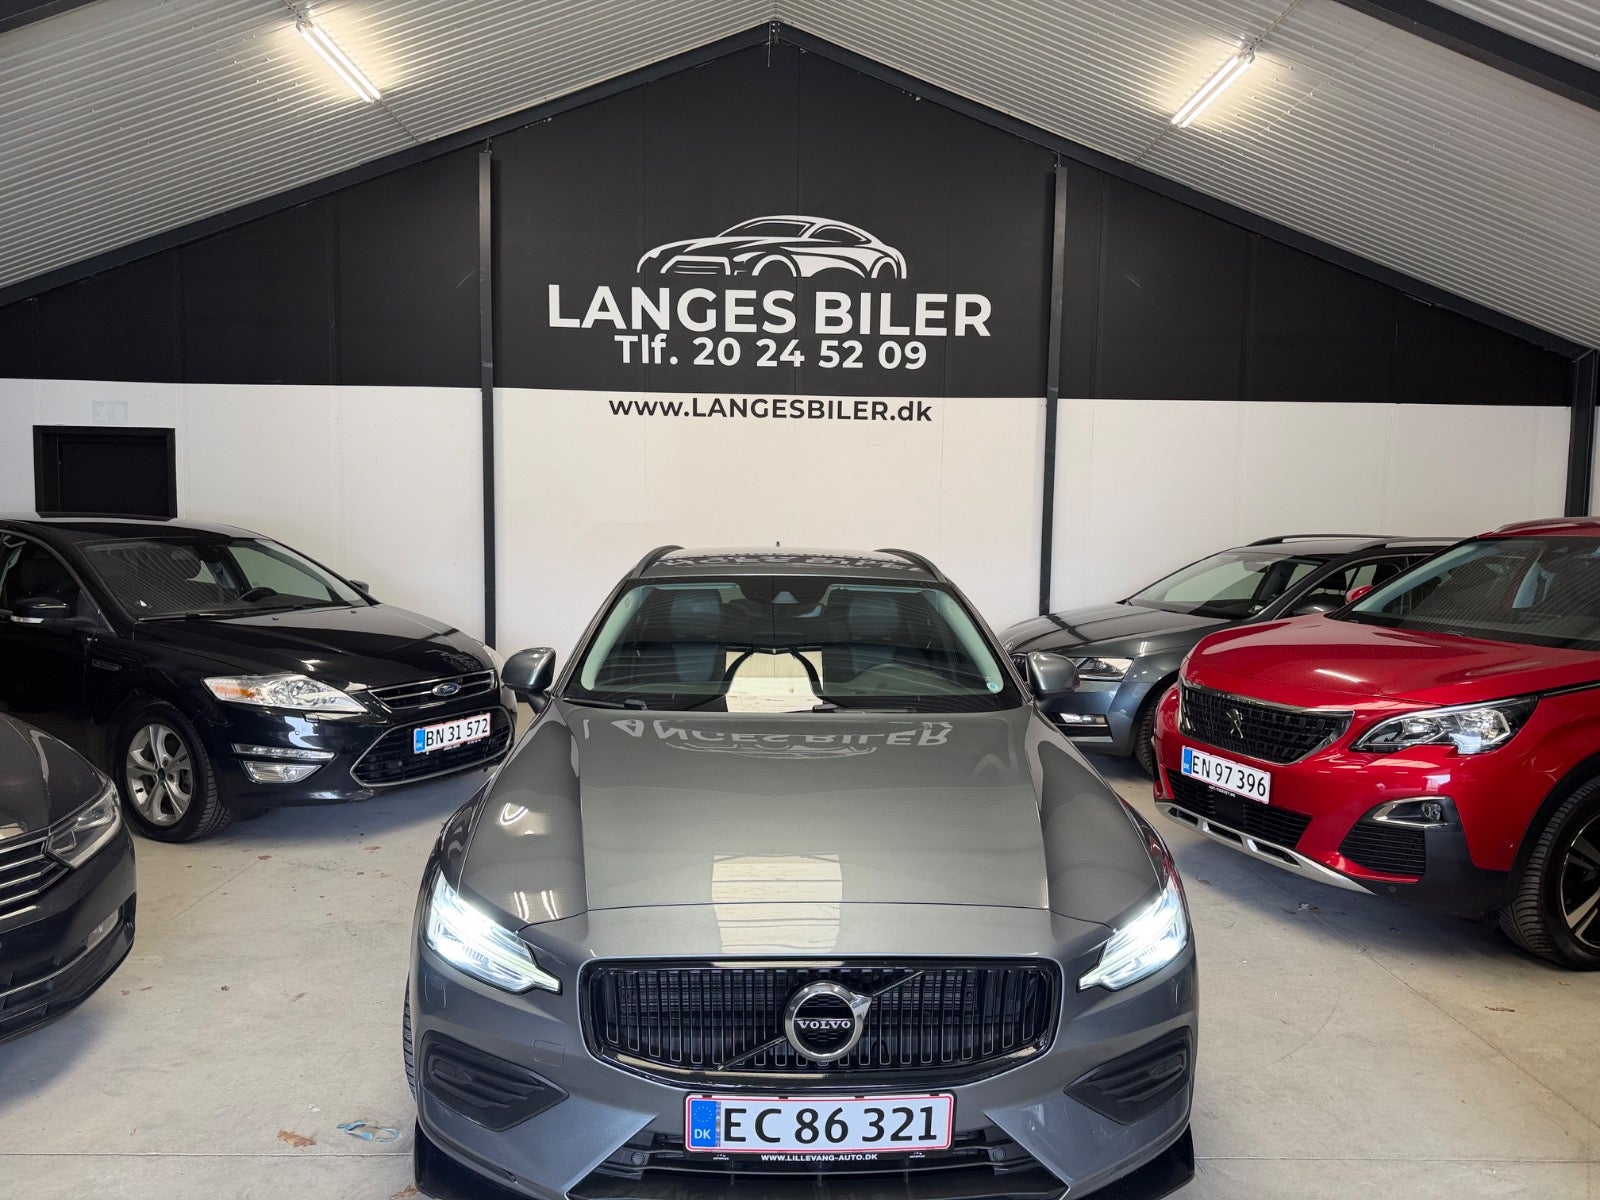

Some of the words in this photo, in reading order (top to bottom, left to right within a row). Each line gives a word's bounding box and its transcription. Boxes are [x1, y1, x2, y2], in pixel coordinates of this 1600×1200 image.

[548, 284, 797, 334] LANGES
[814, 290, 992, 337] BILER
[614, 333, 679, 365] Tlf.
[692, 337, 741, 367] 20
[756, 339, 805, 368] 24
[818, 340, 863, 369] 52
[878, 341, 927, 370] 09
[608, 397, 933, 422] www.LANGESBILER.dk
[426, 728, 444, 746] BN
[447, 725, 461, 742] 31
[466, 718, 488, 737] 572
[1192, 755, 1211, 779] EN
[1215, 763, 1232, 784] 97
[1236, 769, 1266, 797] 396
[797, 1020, 851, 1029] VOLVO
[694, 1128, 711, 1140] DK
[723, 1107, 782, 1143] EC
[794, 1106, 849, 1145] 86
[861, 1106, 937, 1142] 321
[760, 1153, 878, 1162] WWW.LILLEVANG-AUTO.DK
